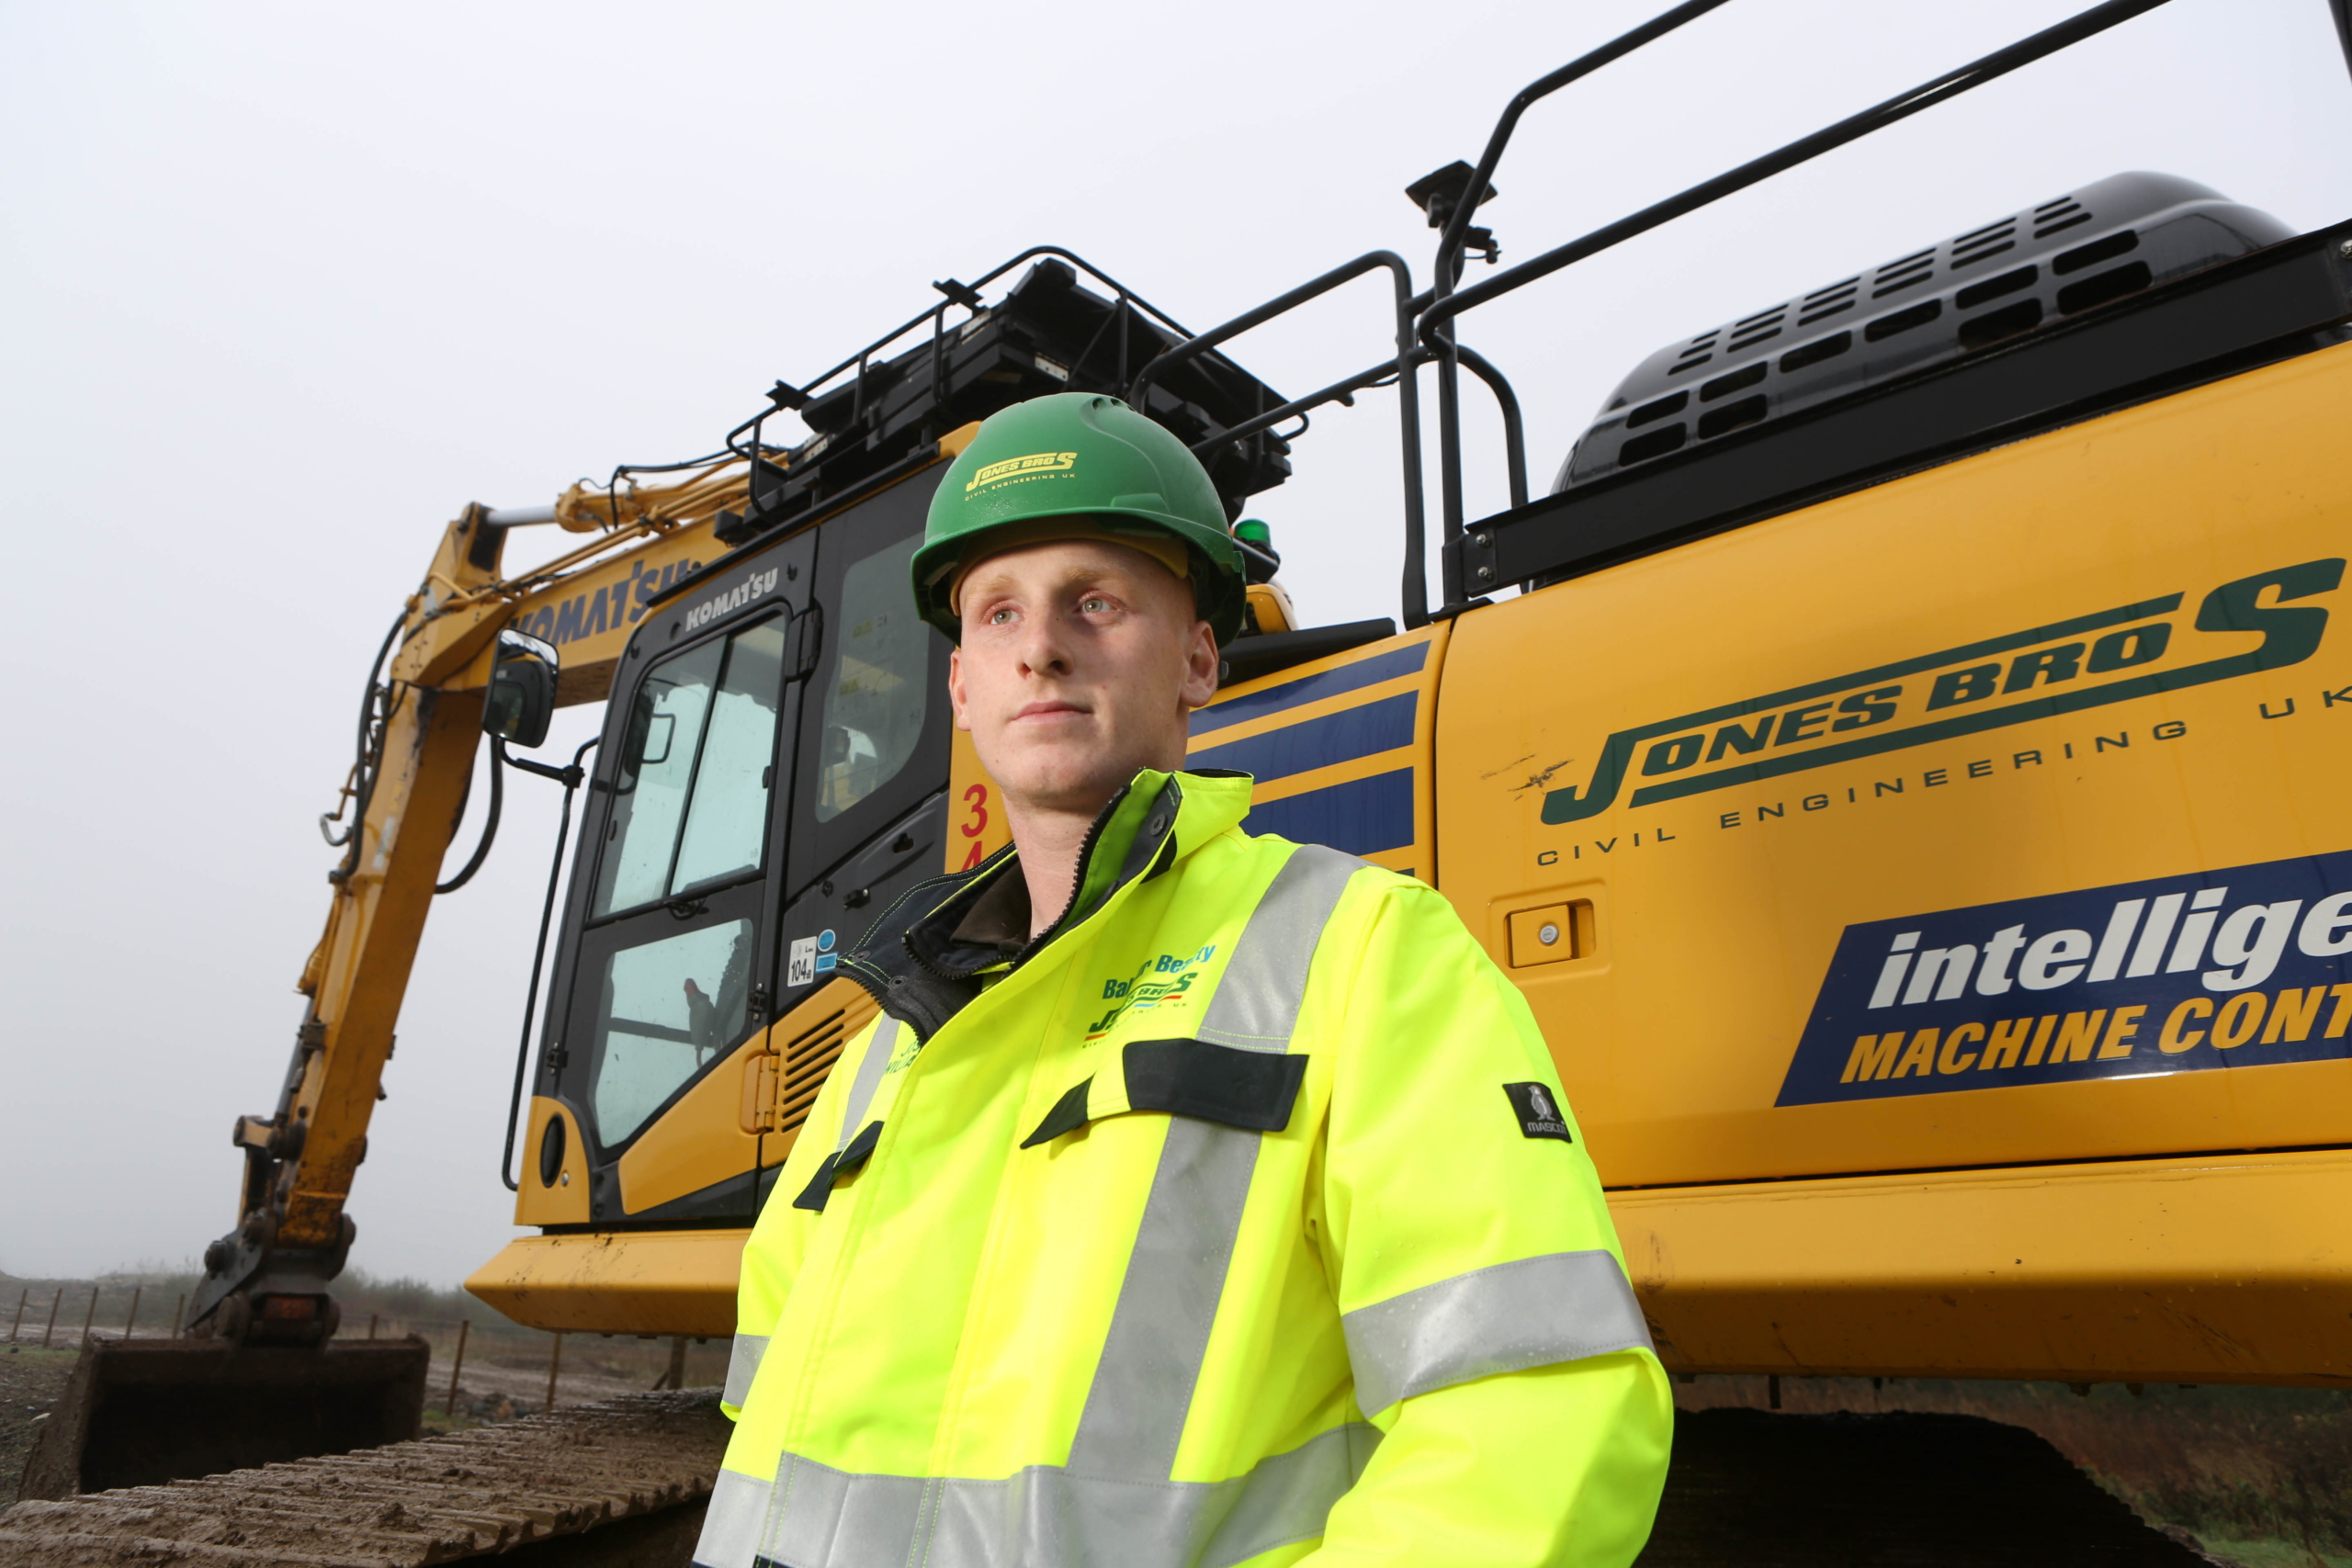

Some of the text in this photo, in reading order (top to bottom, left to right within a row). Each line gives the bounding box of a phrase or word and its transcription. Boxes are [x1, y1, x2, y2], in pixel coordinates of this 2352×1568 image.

[965, 489, 987, 502] CIVIL
[991, 473, 1056, 491] ENGINEERING
[966, 452, 1078, 492] JONES BROS
[685, 567, 778, 632] KOMATSU
[1540, 557, 2347, 826] JONES BROS
[1537, 685, 2352, 867] CIVIL ENGINEERING UK
[791, 958, 807, 982] 104
[1839, 1005, 2148, 1084] MACHINE
